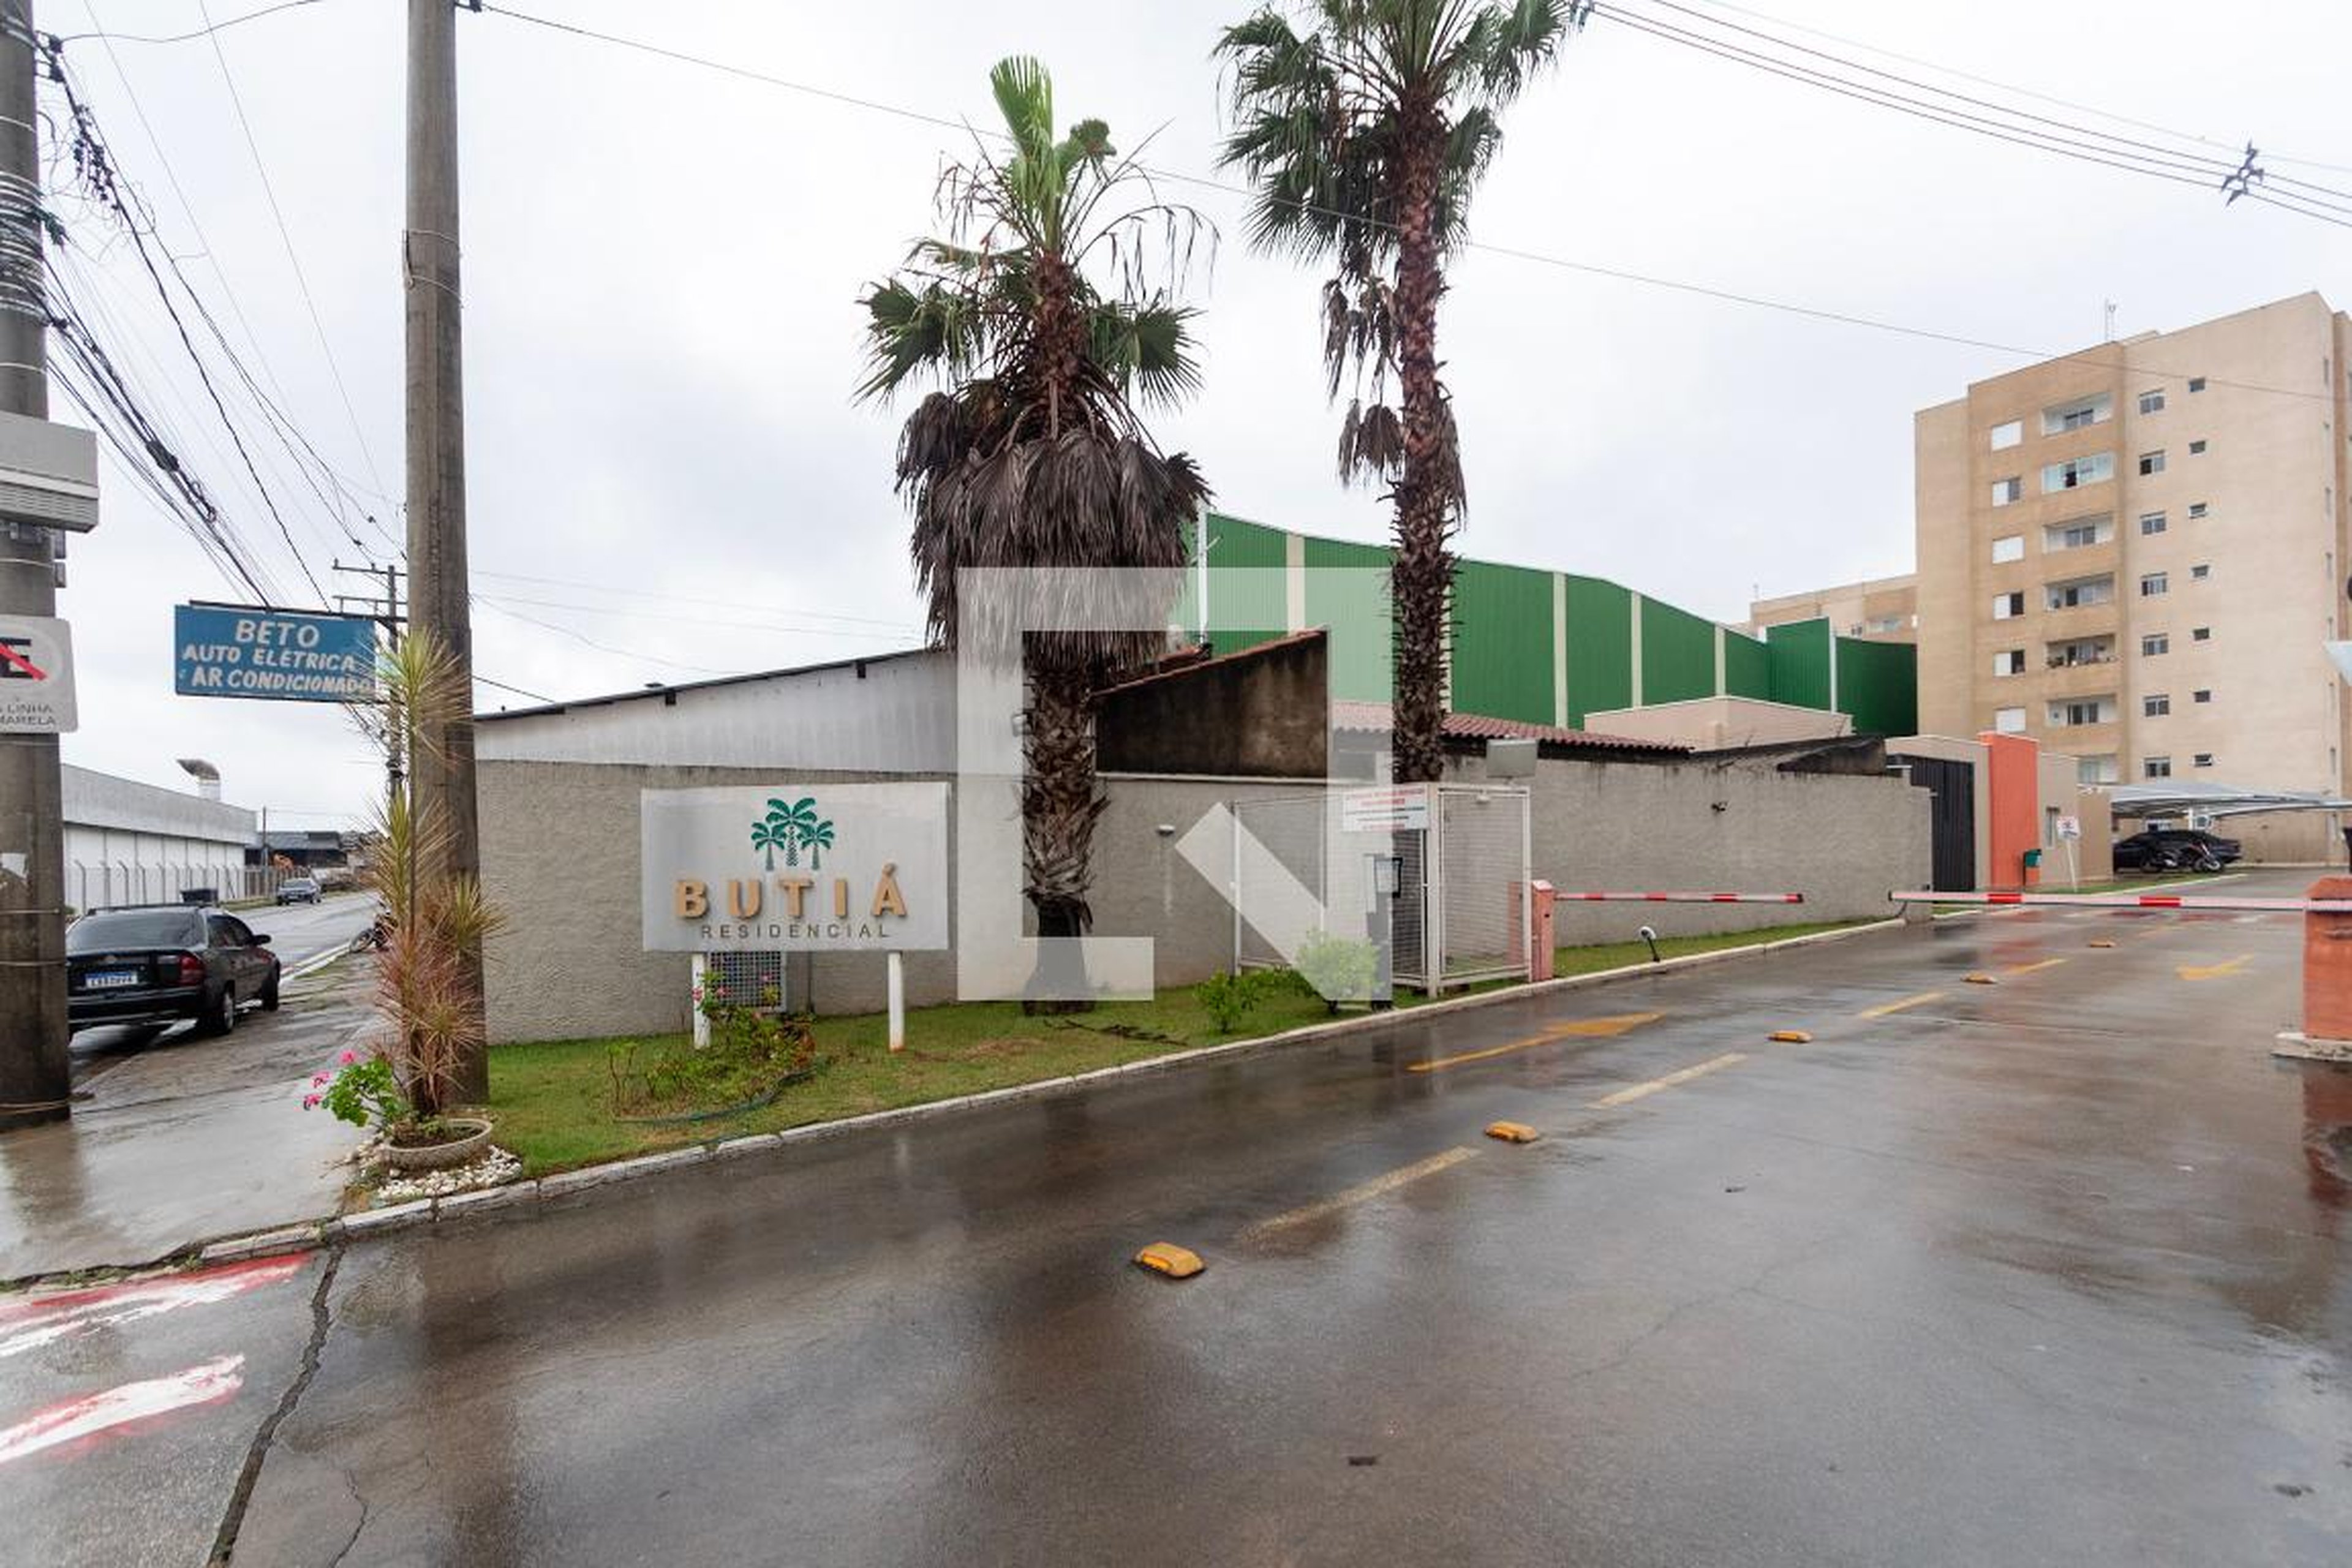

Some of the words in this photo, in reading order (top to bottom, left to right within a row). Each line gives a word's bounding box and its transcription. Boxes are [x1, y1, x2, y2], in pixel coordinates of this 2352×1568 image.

[235, 619, 320, 647] BETO
[183, 644, 241, 663] AUTO
[192, 665, 223, 687] AR
[227, 668, 372, 694] CONDICIONADO
[7, 704, 53, 714] LINHA
[677, 862, 908, 919] BUTIÁ
[701, 924, 891, 939] RESIDENCIAL
